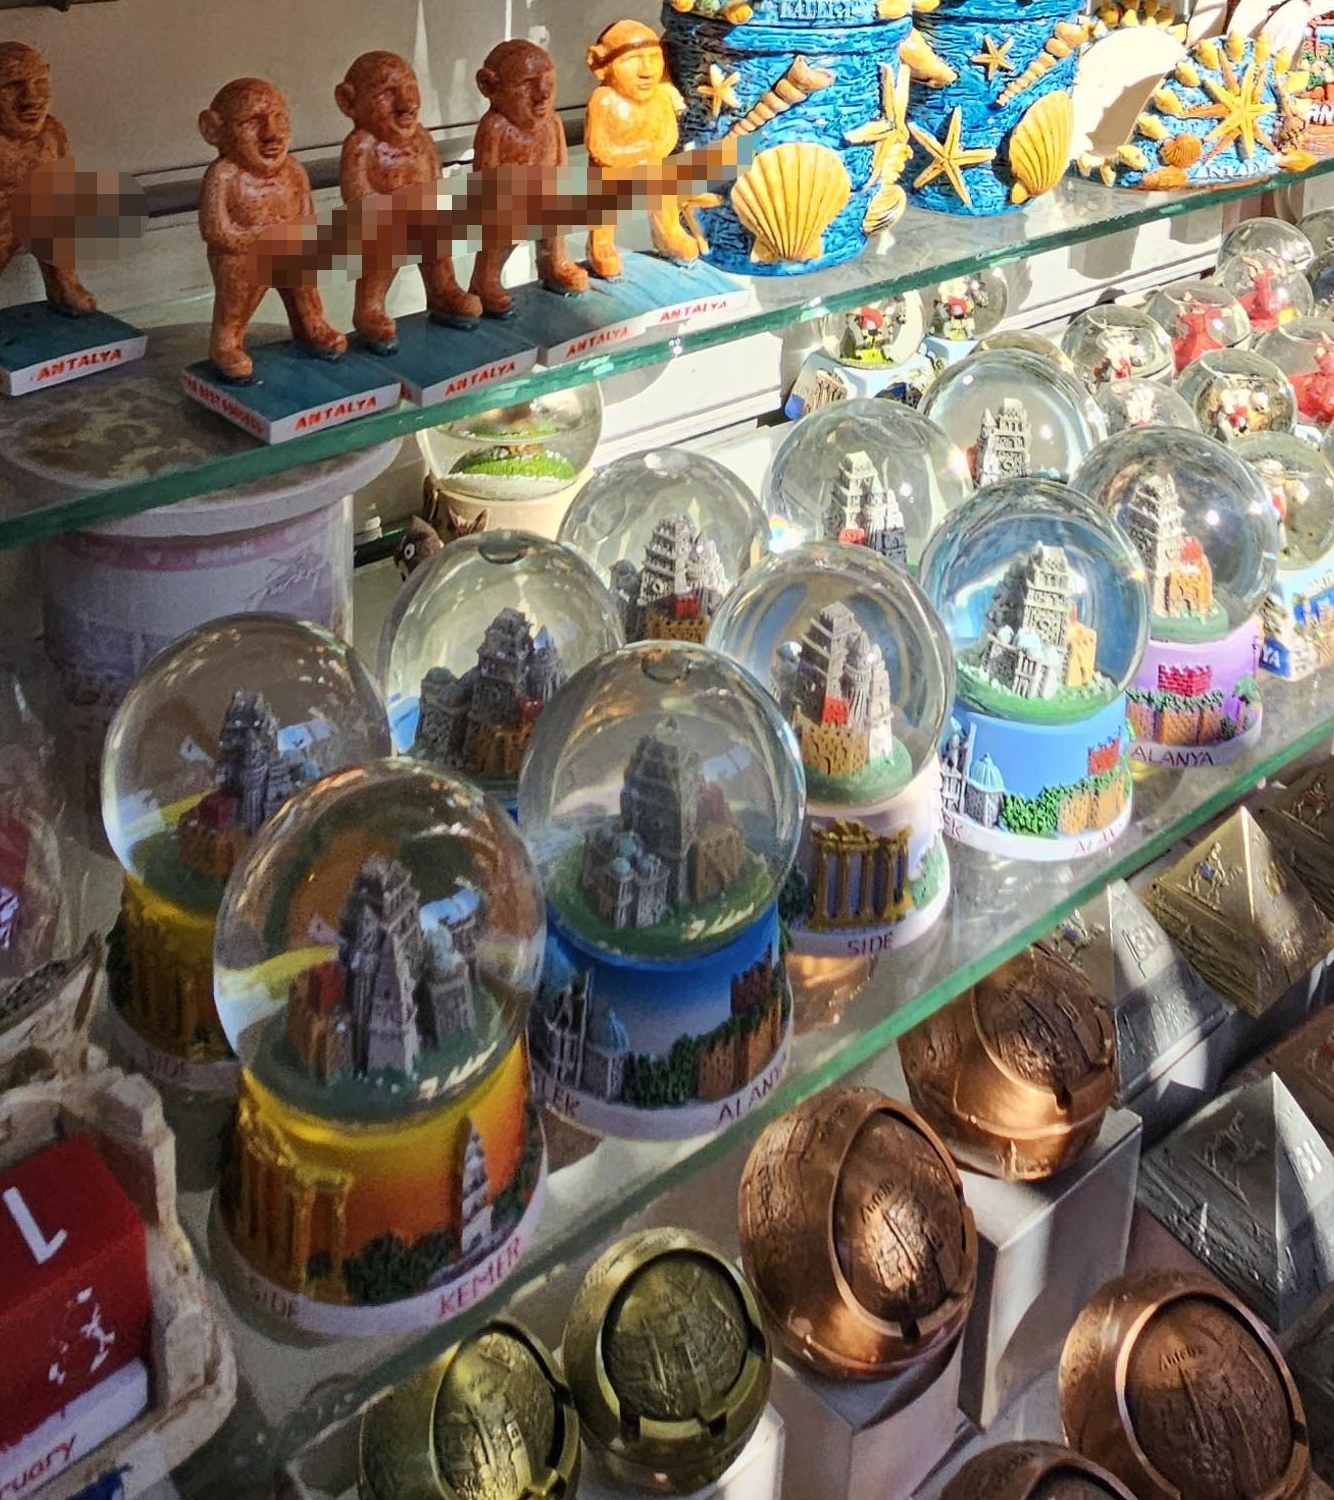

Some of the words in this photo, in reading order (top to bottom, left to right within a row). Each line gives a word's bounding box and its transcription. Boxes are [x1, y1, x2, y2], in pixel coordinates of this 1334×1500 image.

[657, 299, 729, 323] ANTALYA
[566, 325, 631, 357] ANTALYA
[35, 348, 124, 382] ANTALYA
[444, 361, 517, 396] ANTALYA
[293, 396, 377, 432] ANTALYA
[1131, 746, 1214, 767] ALANYA
[847, 934, 893, 955] SIDE
[438, 1236, 524, 1317] KEMER
